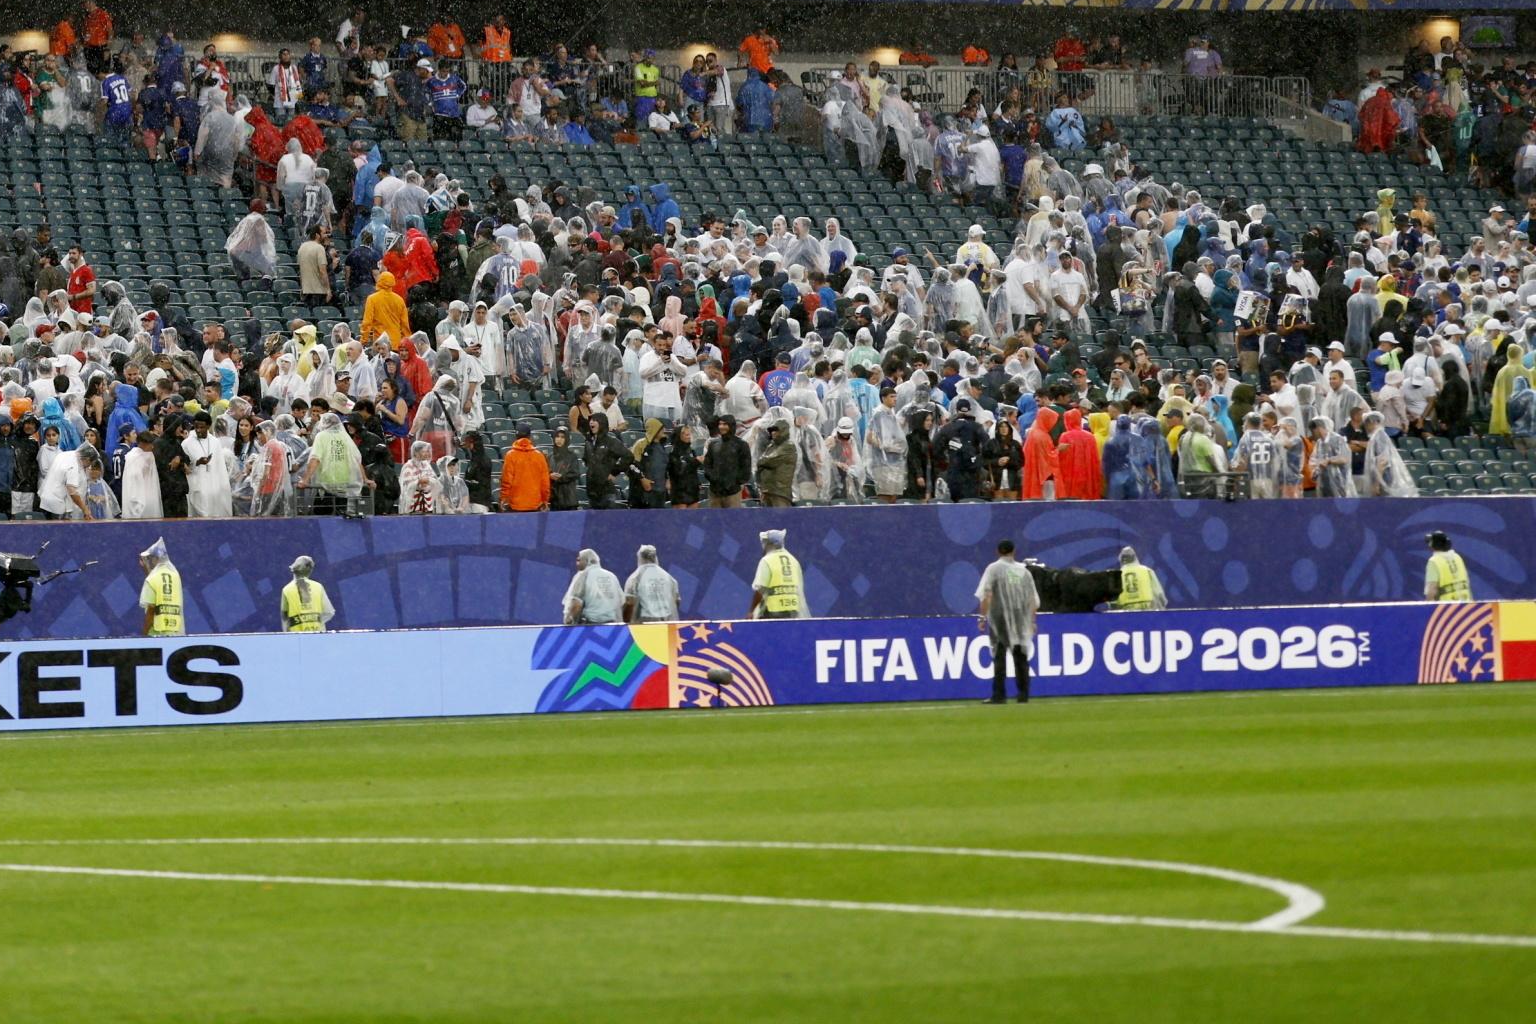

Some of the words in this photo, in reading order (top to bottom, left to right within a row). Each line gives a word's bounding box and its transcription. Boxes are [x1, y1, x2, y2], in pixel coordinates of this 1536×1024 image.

[113, 85, 129, 104] 10
[501, 265, 517, 287] 10
[1238, 295, 1249, 312] VISA
[816, 638, 918, 683] FIFA
[1102, 630, 1193, 675] CUP
[1201, 624, 1358, 672] 2026
